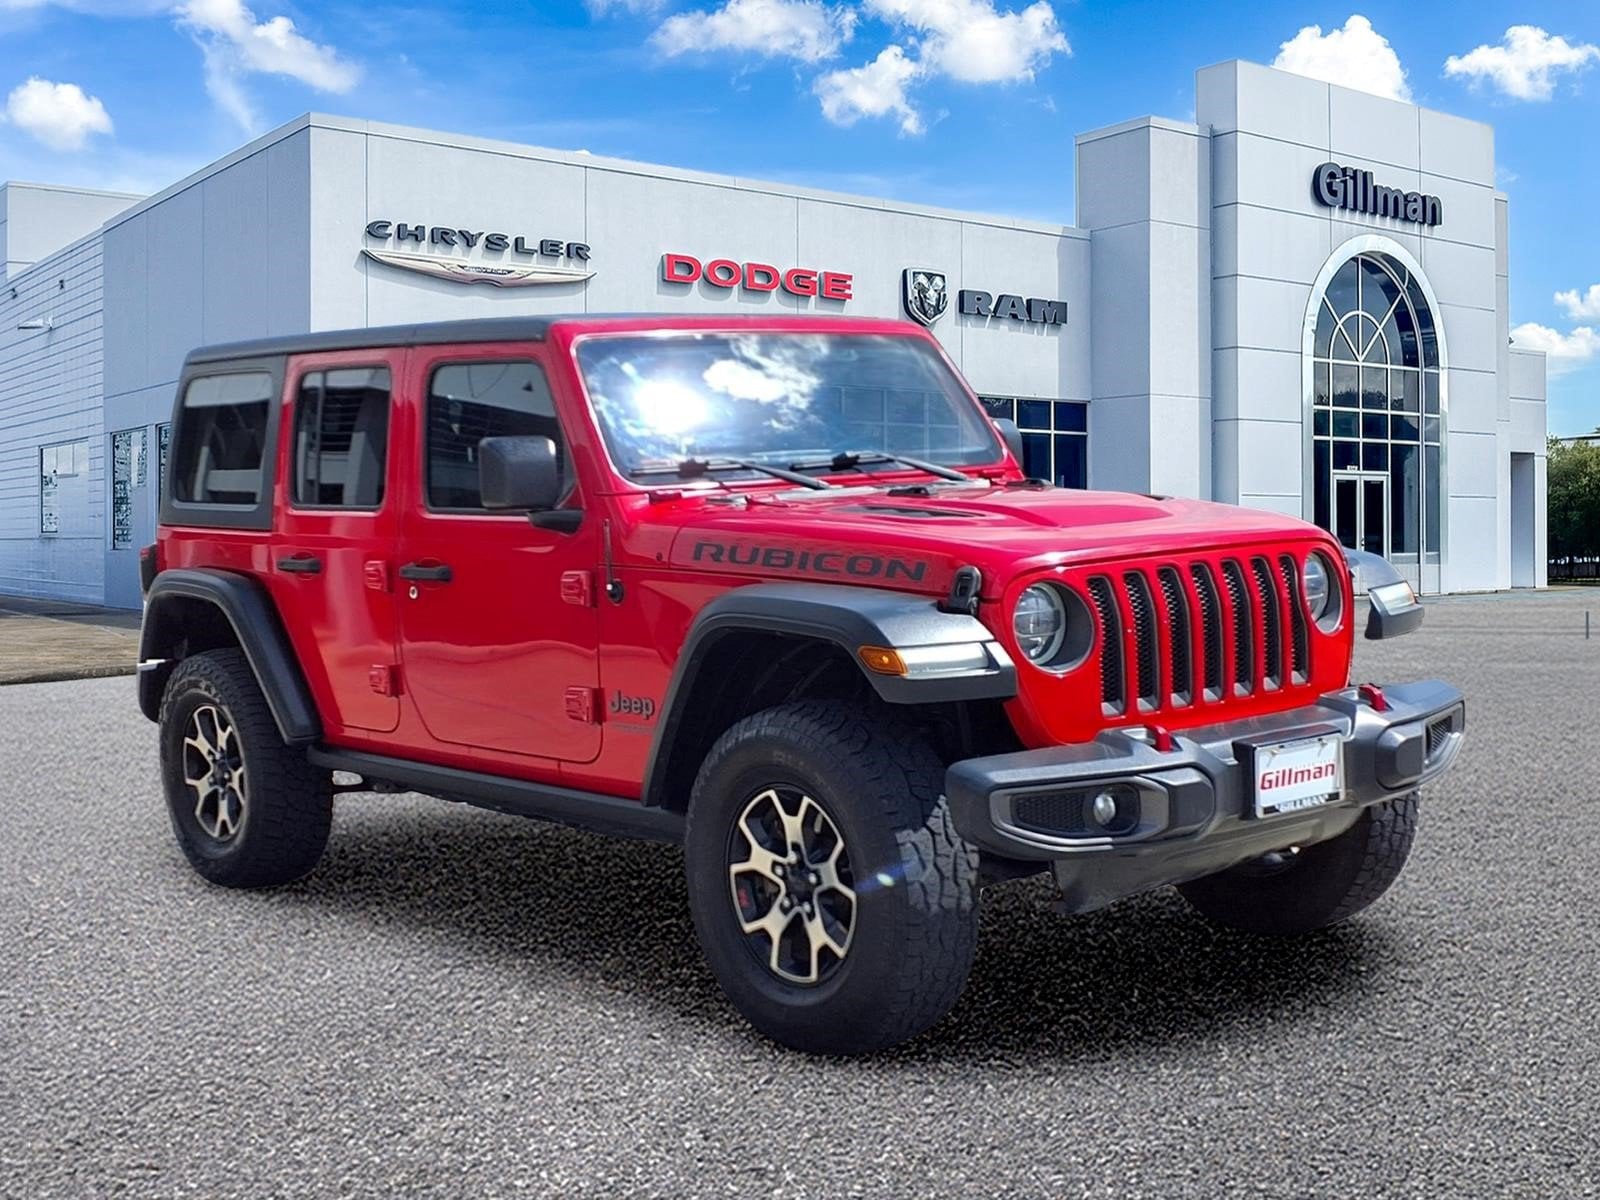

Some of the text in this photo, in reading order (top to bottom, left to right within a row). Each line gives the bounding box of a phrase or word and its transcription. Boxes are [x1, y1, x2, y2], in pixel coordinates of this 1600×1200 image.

[1312, 162, 1443, 226] Gillman
[366, 220, 592, 260] CHRYSLER
[661, 253, 853, 300] DODGE
[959, 289, 1068, 325] RAM
[693, 541, 927, 582] RUBICON
[610, 690, 655, 720] Jeep
[1260, 763, 1335, 790] Gillman
